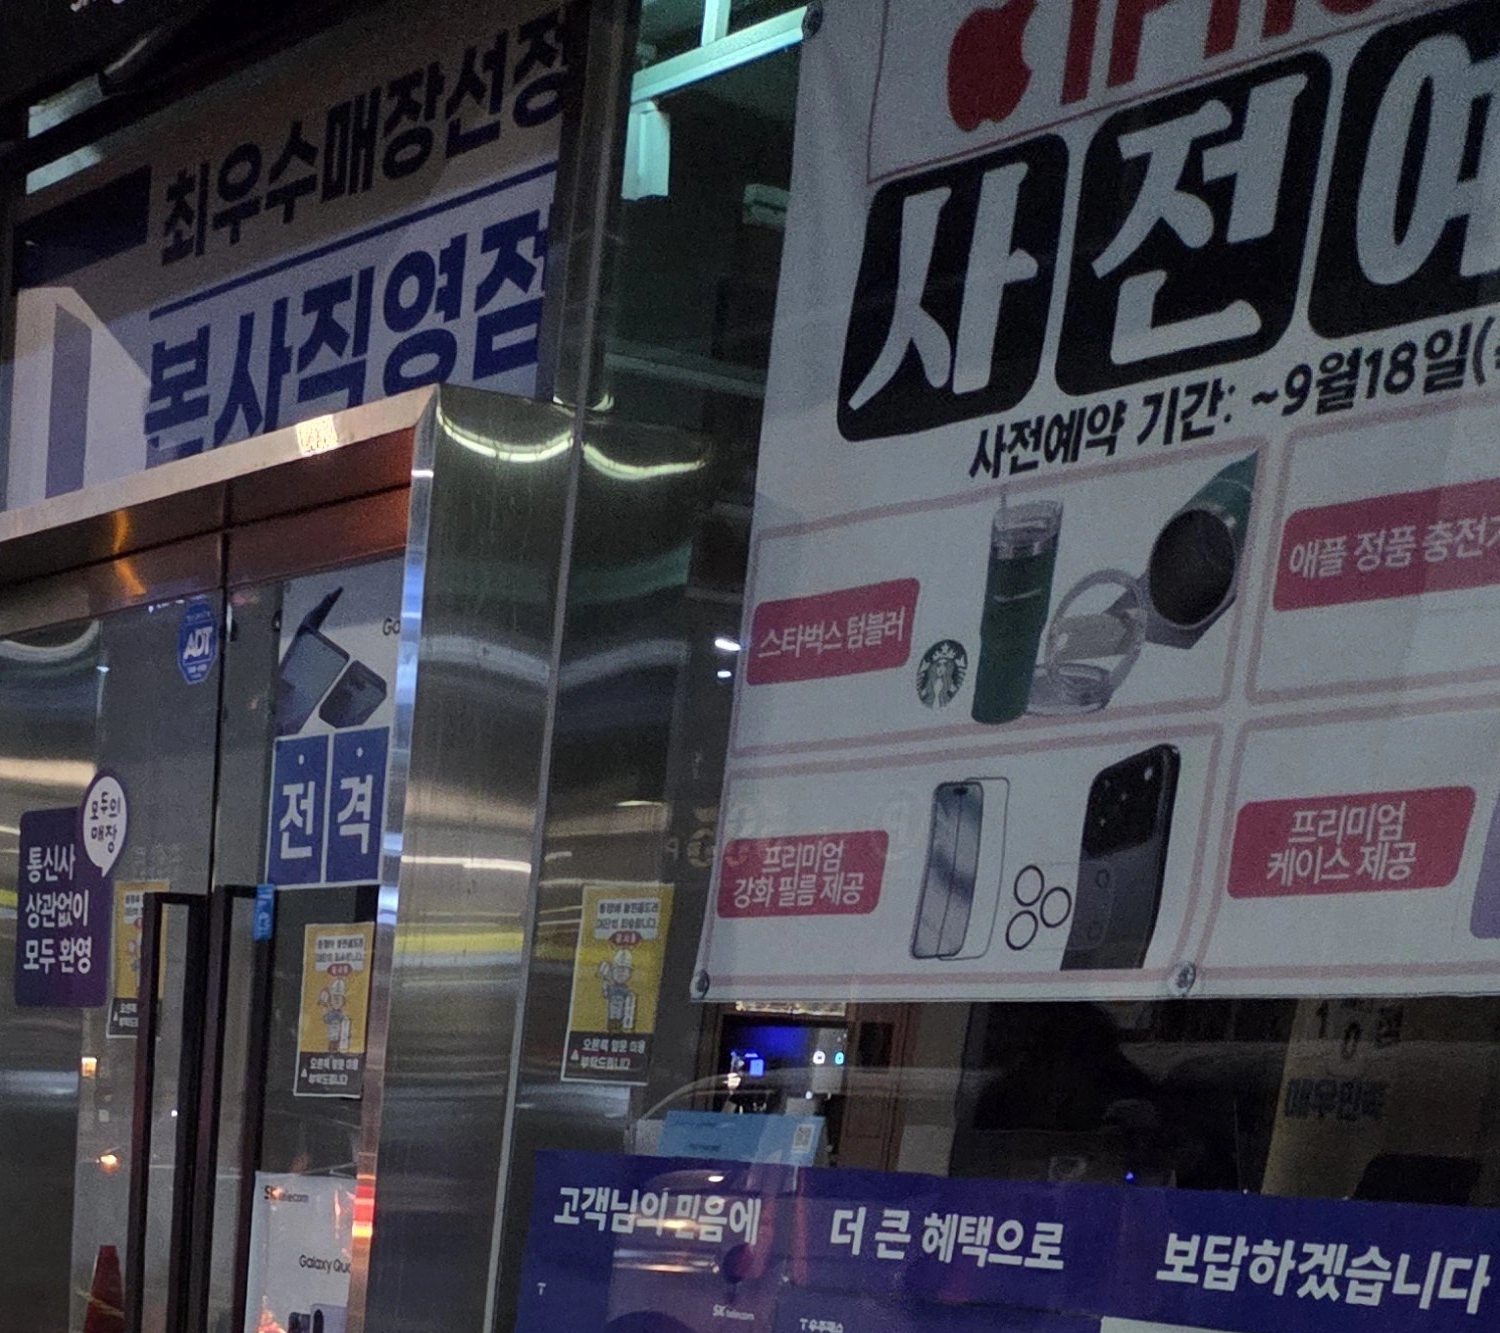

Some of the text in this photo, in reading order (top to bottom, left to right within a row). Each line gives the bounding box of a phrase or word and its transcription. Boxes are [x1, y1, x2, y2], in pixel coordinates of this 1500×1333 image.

[161, 8, 564, 266] 최우수매장선정
[145, 210, 545, 458] 본사직영점
[969, 320, 1500, 479] 사전예약 기간: ~9월18일(
[1289, 535, 1348, 580] 애플
[1353, 525, 1418, 574] 정품
[183, 626, 213, 660] ADT
[758, 606, 906, 658] 스타벅스 텀블러
[91, 791, 121, 820] 모두의
[1287, 801, 1407, 846] 프리미엄
[91, 825, 117, 854] 매장
[762, 840, 844, 874] 프리미엄
[27, 844, 75, 883] 통신사
[1266, 840, 1418, 887] 케이스 제공
[25, 889, 89, 928] 상관없이
[733, 871, 865, 909] 강화 필름 제공
[23, 935, 93, 975] 모두 환영
[299, 1254, 332, 1275] Galaxy
[554, 1187, 1493, 1315] 고객님의 믿음에 더 큰 혜택으로 보답하겠습니다
[712, 1304, 725, 1319] SK
